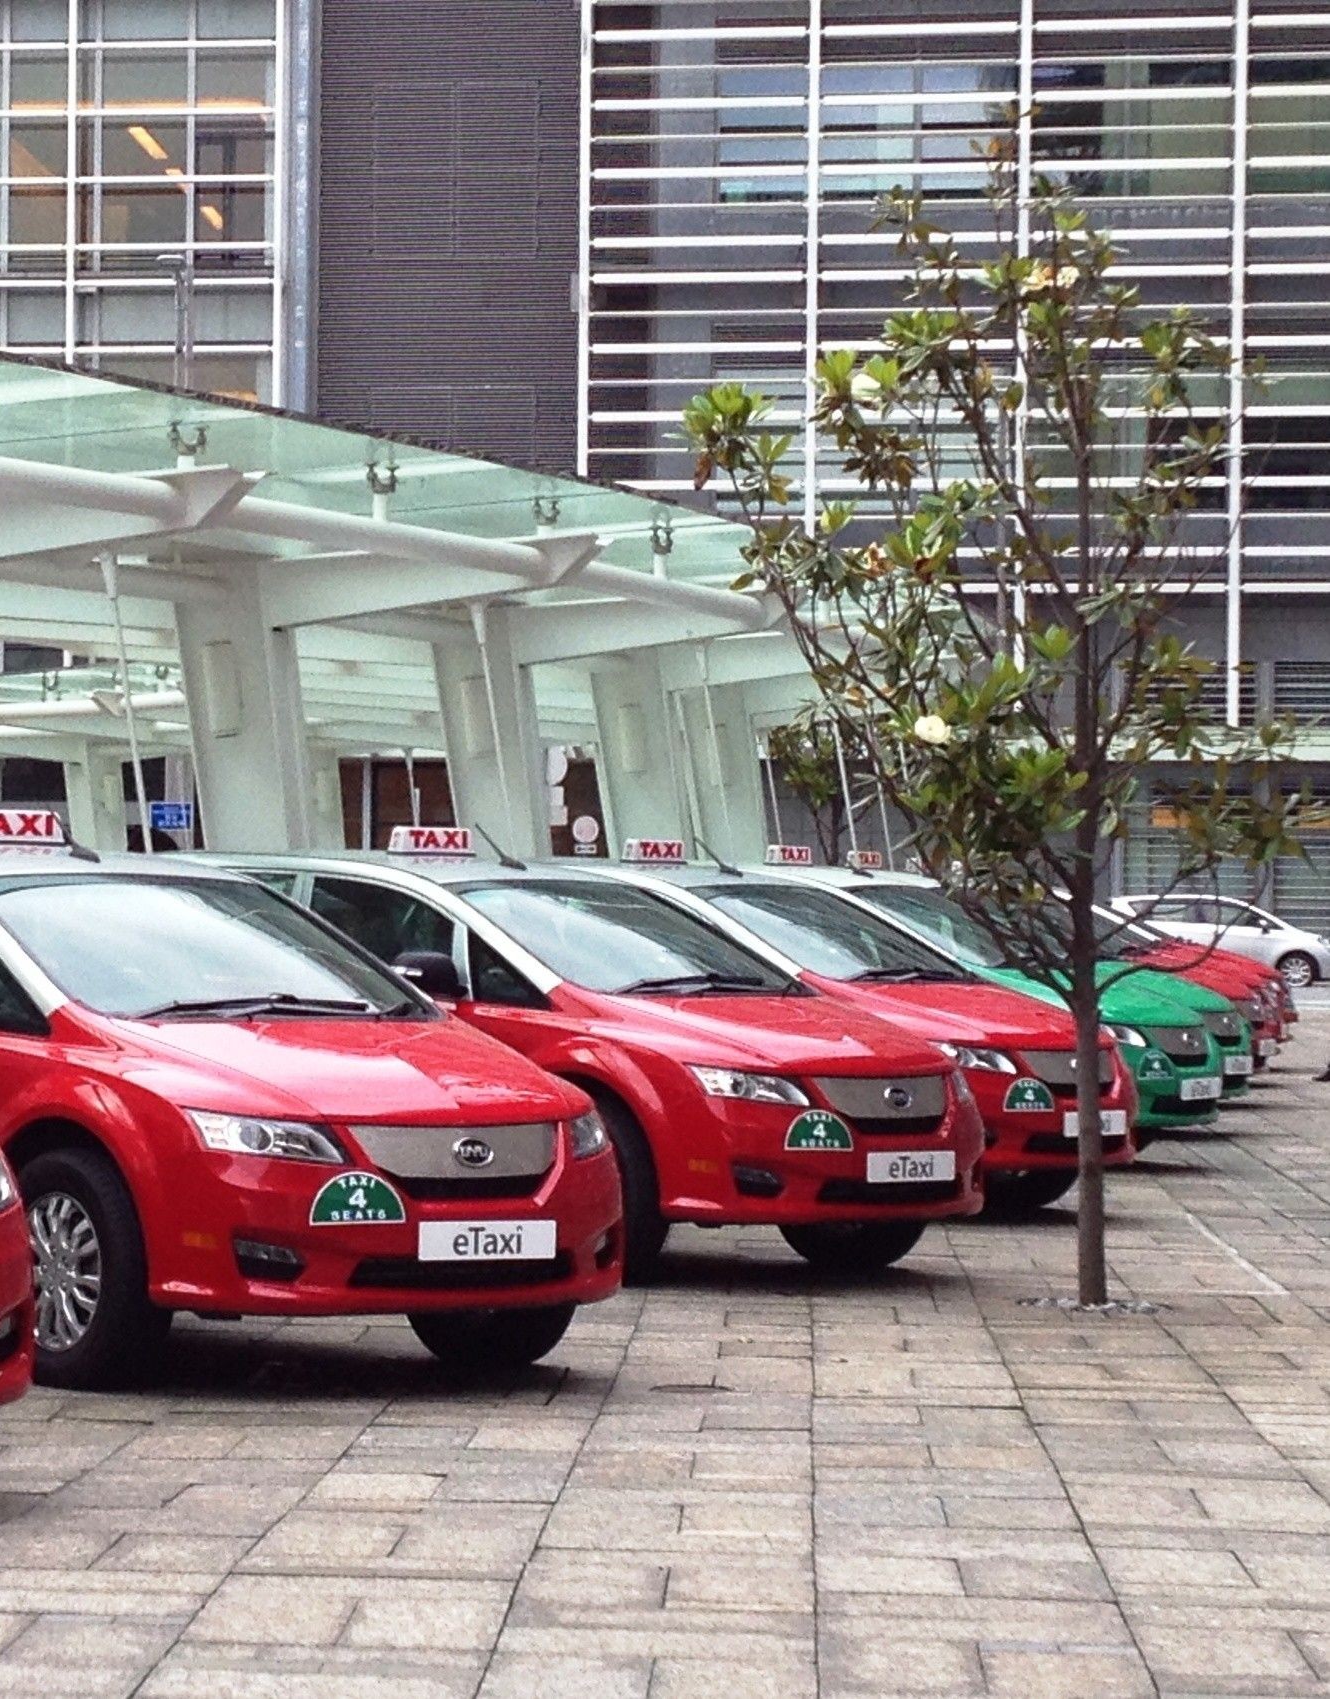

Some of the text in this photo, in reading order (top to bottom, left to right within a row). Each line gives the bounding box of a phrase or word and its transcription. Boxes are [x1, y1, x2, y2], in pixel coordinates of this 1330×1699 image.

[410, 830, 468, 849] TAXI
[640, 841, 682, 858] TAXI
[813, 1123, 826, 1138] 4
[889, 1155, 934, 1179] eTaxi
[337, 1175, 376, 1188] TAXI
[348, 1188, 367, 1208] 4
[331, 1209, 387, 1220] SEATS
[453, 1226, 523, 1256] eTaxi
